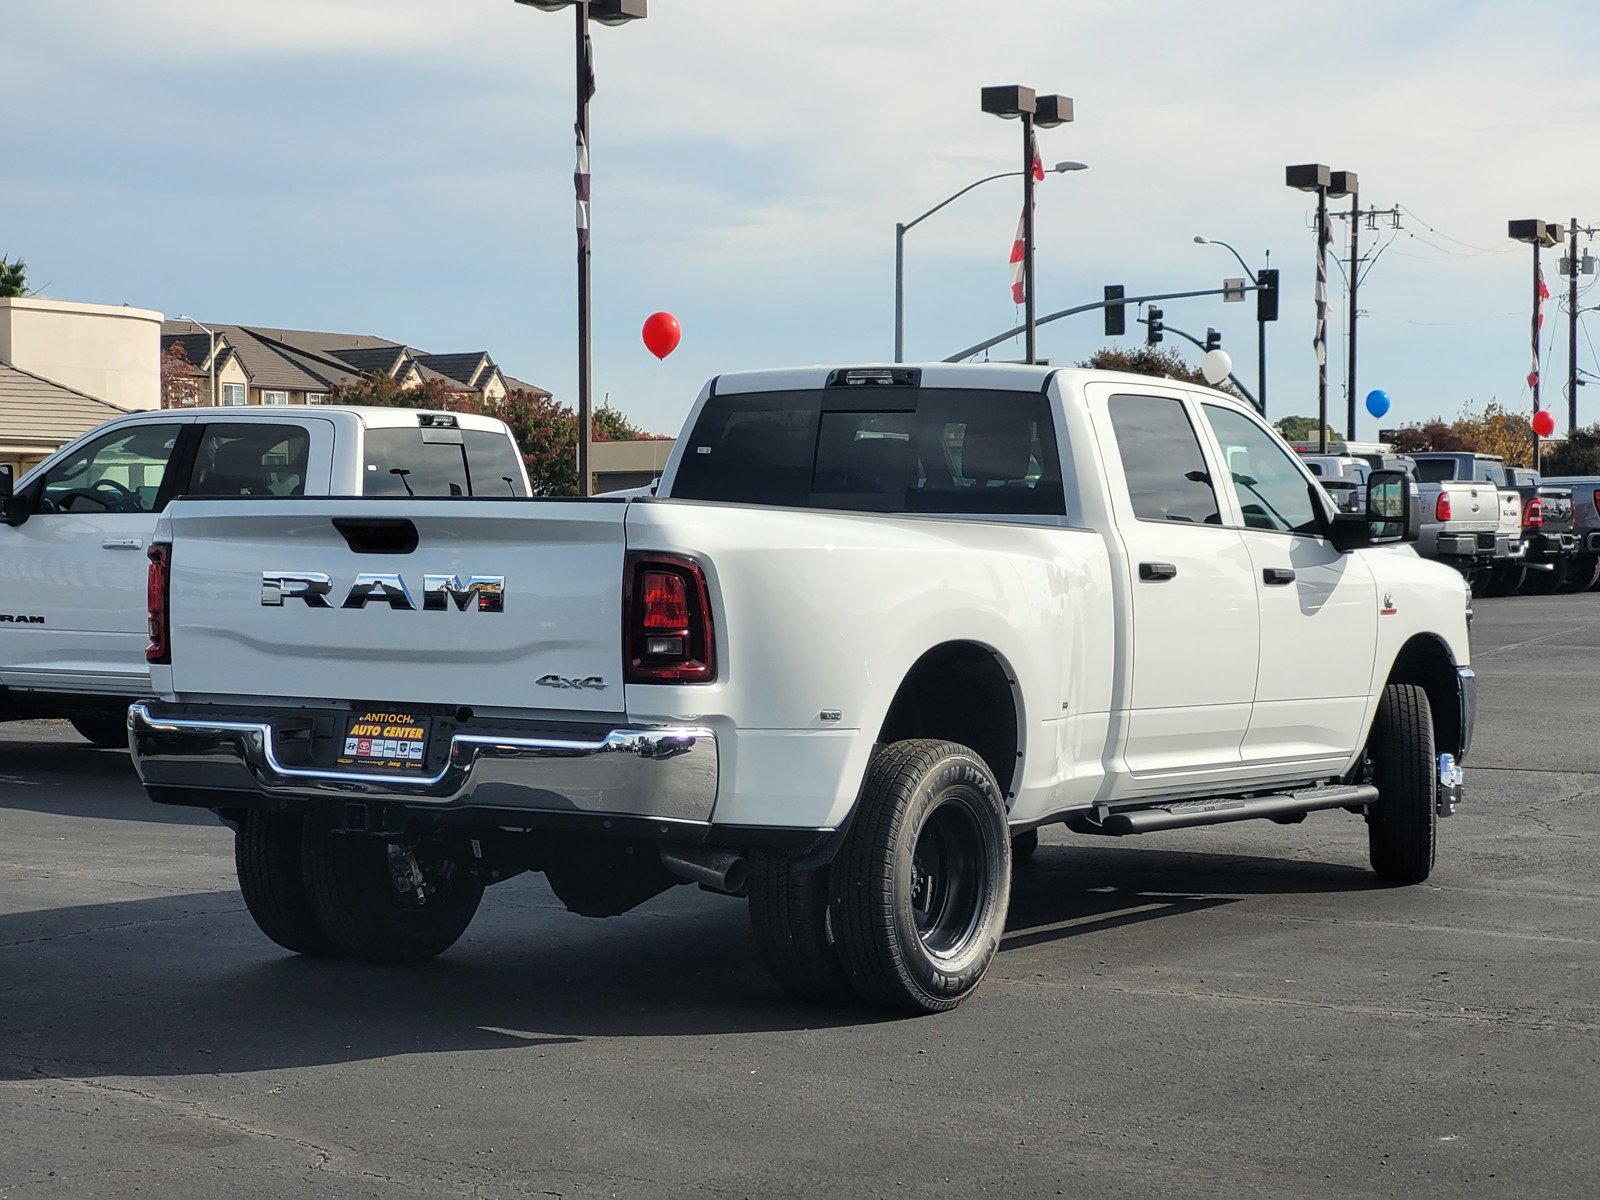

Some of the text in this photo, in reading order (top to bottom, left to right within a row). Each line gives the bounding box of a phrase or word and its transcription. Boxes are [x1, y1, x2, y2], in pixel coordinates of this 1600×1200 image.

[261, 571, 506, 613] RAM
[0, 614, 45, 624] RAM
[363, 713, 411, 724] ANTIOCH
[350, 724, 424, 738] AUTO CENTER
[963, 766, 991, 794] HTX
